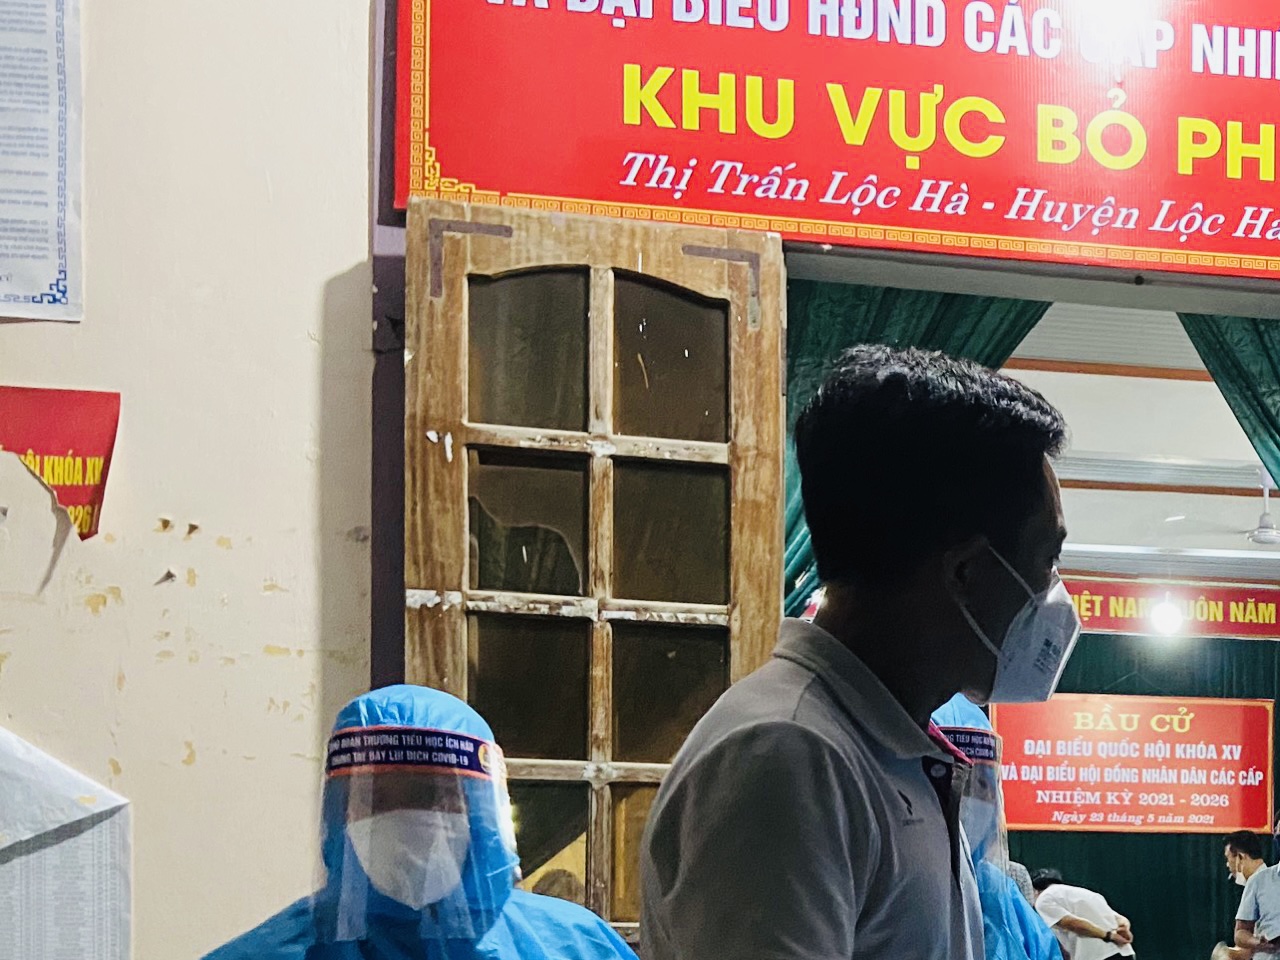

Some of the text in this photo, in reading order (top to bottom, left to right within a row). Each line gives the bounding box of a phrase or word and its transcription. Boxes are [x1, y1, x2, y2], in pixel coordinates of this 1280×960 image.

[808, 0, 947, 47] HĐND
[963, 0, 1063, 60] CÁC
[622, 63, 795, 139] KHU
[825, 82, 1006, 170] VỰC
[1036, 87, 1148, 171] BỎ
[619, 152, 698, 200] Thị
[706, 160, 810, 202] Trấn
[819, 171, 901, 217] Lộc
[908, 179, 970, 217] Hà
[1003, 187, 1140, 236] Huyện
[1147, 199, 1226, 243] Lộc
[44, 449, 83, 486] KHÓA
[1069, 590, 1277, 624] IỆT NA UÔN NĂM
[1073, 703, 1195, 733] BẦU CỬ
[1024, 735, 1243, 762] ĐẠI BIỂU QUỐC HỘI KHÓA XV
[1001, 761, 1018, 781] VÀ
[1021, 765, 1043, 785] ĐẠI
[1046, 760, 1076, 782] BIỂU
[1080, 764, 1101, 786] HỘI
[1142, 765, 1178, 785] NHÂN
[1180, 766, 1207, 785] DÂN
[1210, 767, 1235, 786] CÁC
[1238, 765, 1264, 787] CẤP
[1036, 787, 1102, 808] NHIỆM
[1106, 788, 1133, 806] KỲ
[1138, 793, 1175, 807] 2021
[1190, 793, 1229, 807] 2026
[1052, 810, 1215, 826] Ngày 23 tháng 5 năm 2021
